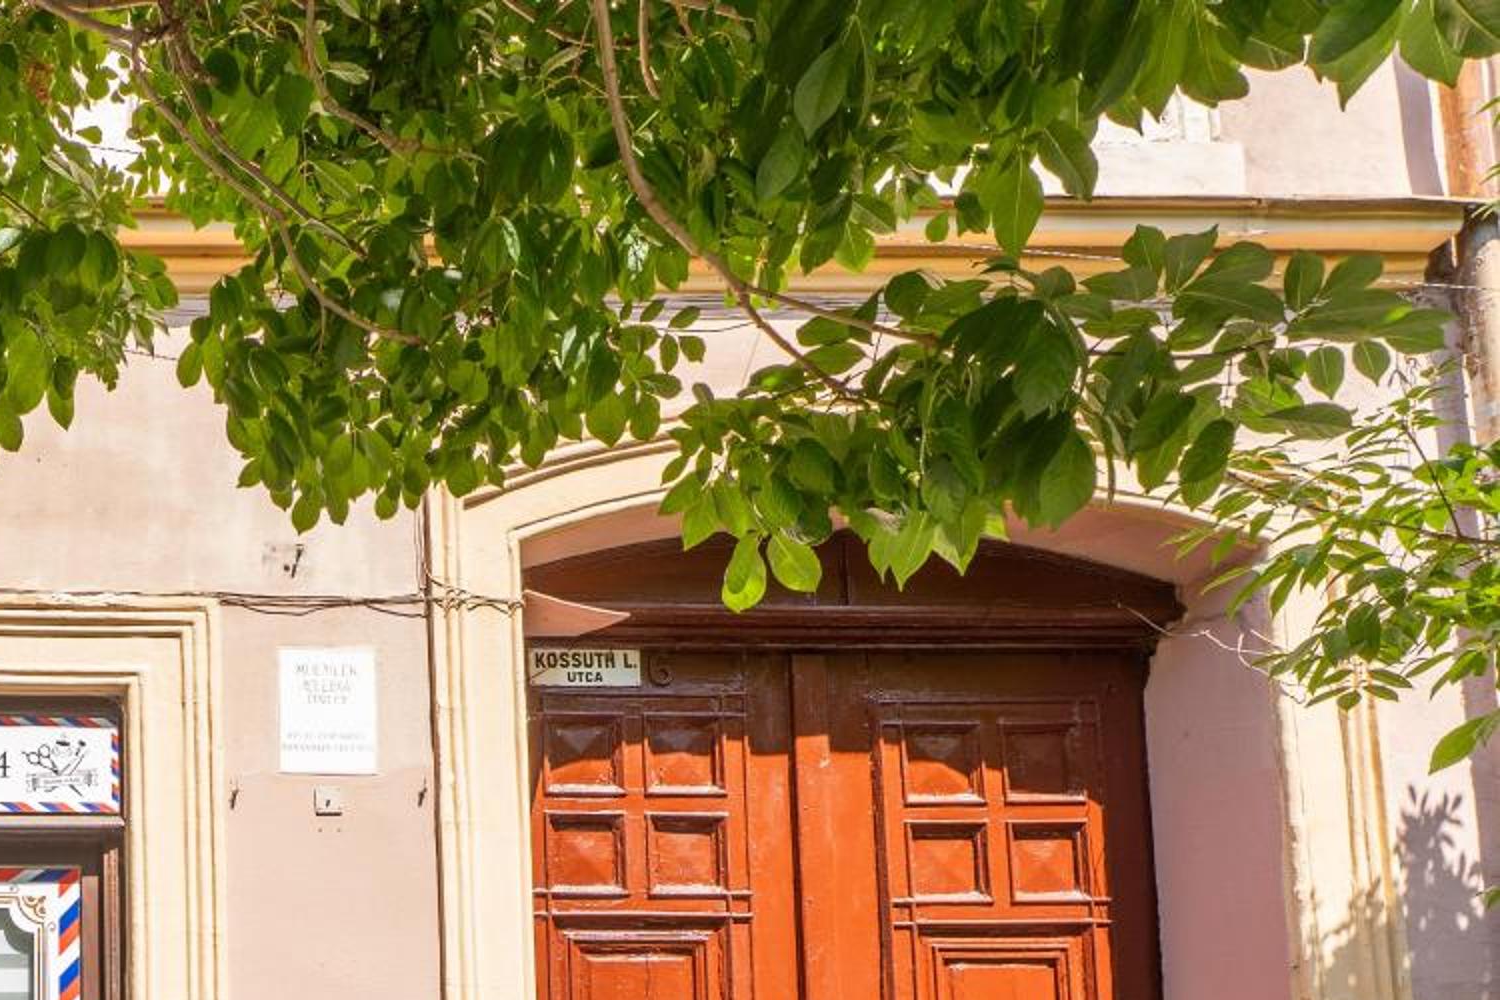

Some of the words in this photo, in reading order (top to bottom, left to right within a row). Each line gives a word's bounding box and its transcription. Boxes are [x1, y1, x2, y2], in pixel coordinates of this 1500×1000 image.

[535, 651, 615, 669] KOSSUTH
[623, 652, 637, 669] L.
[567, 671, 603, 683] UTCA
